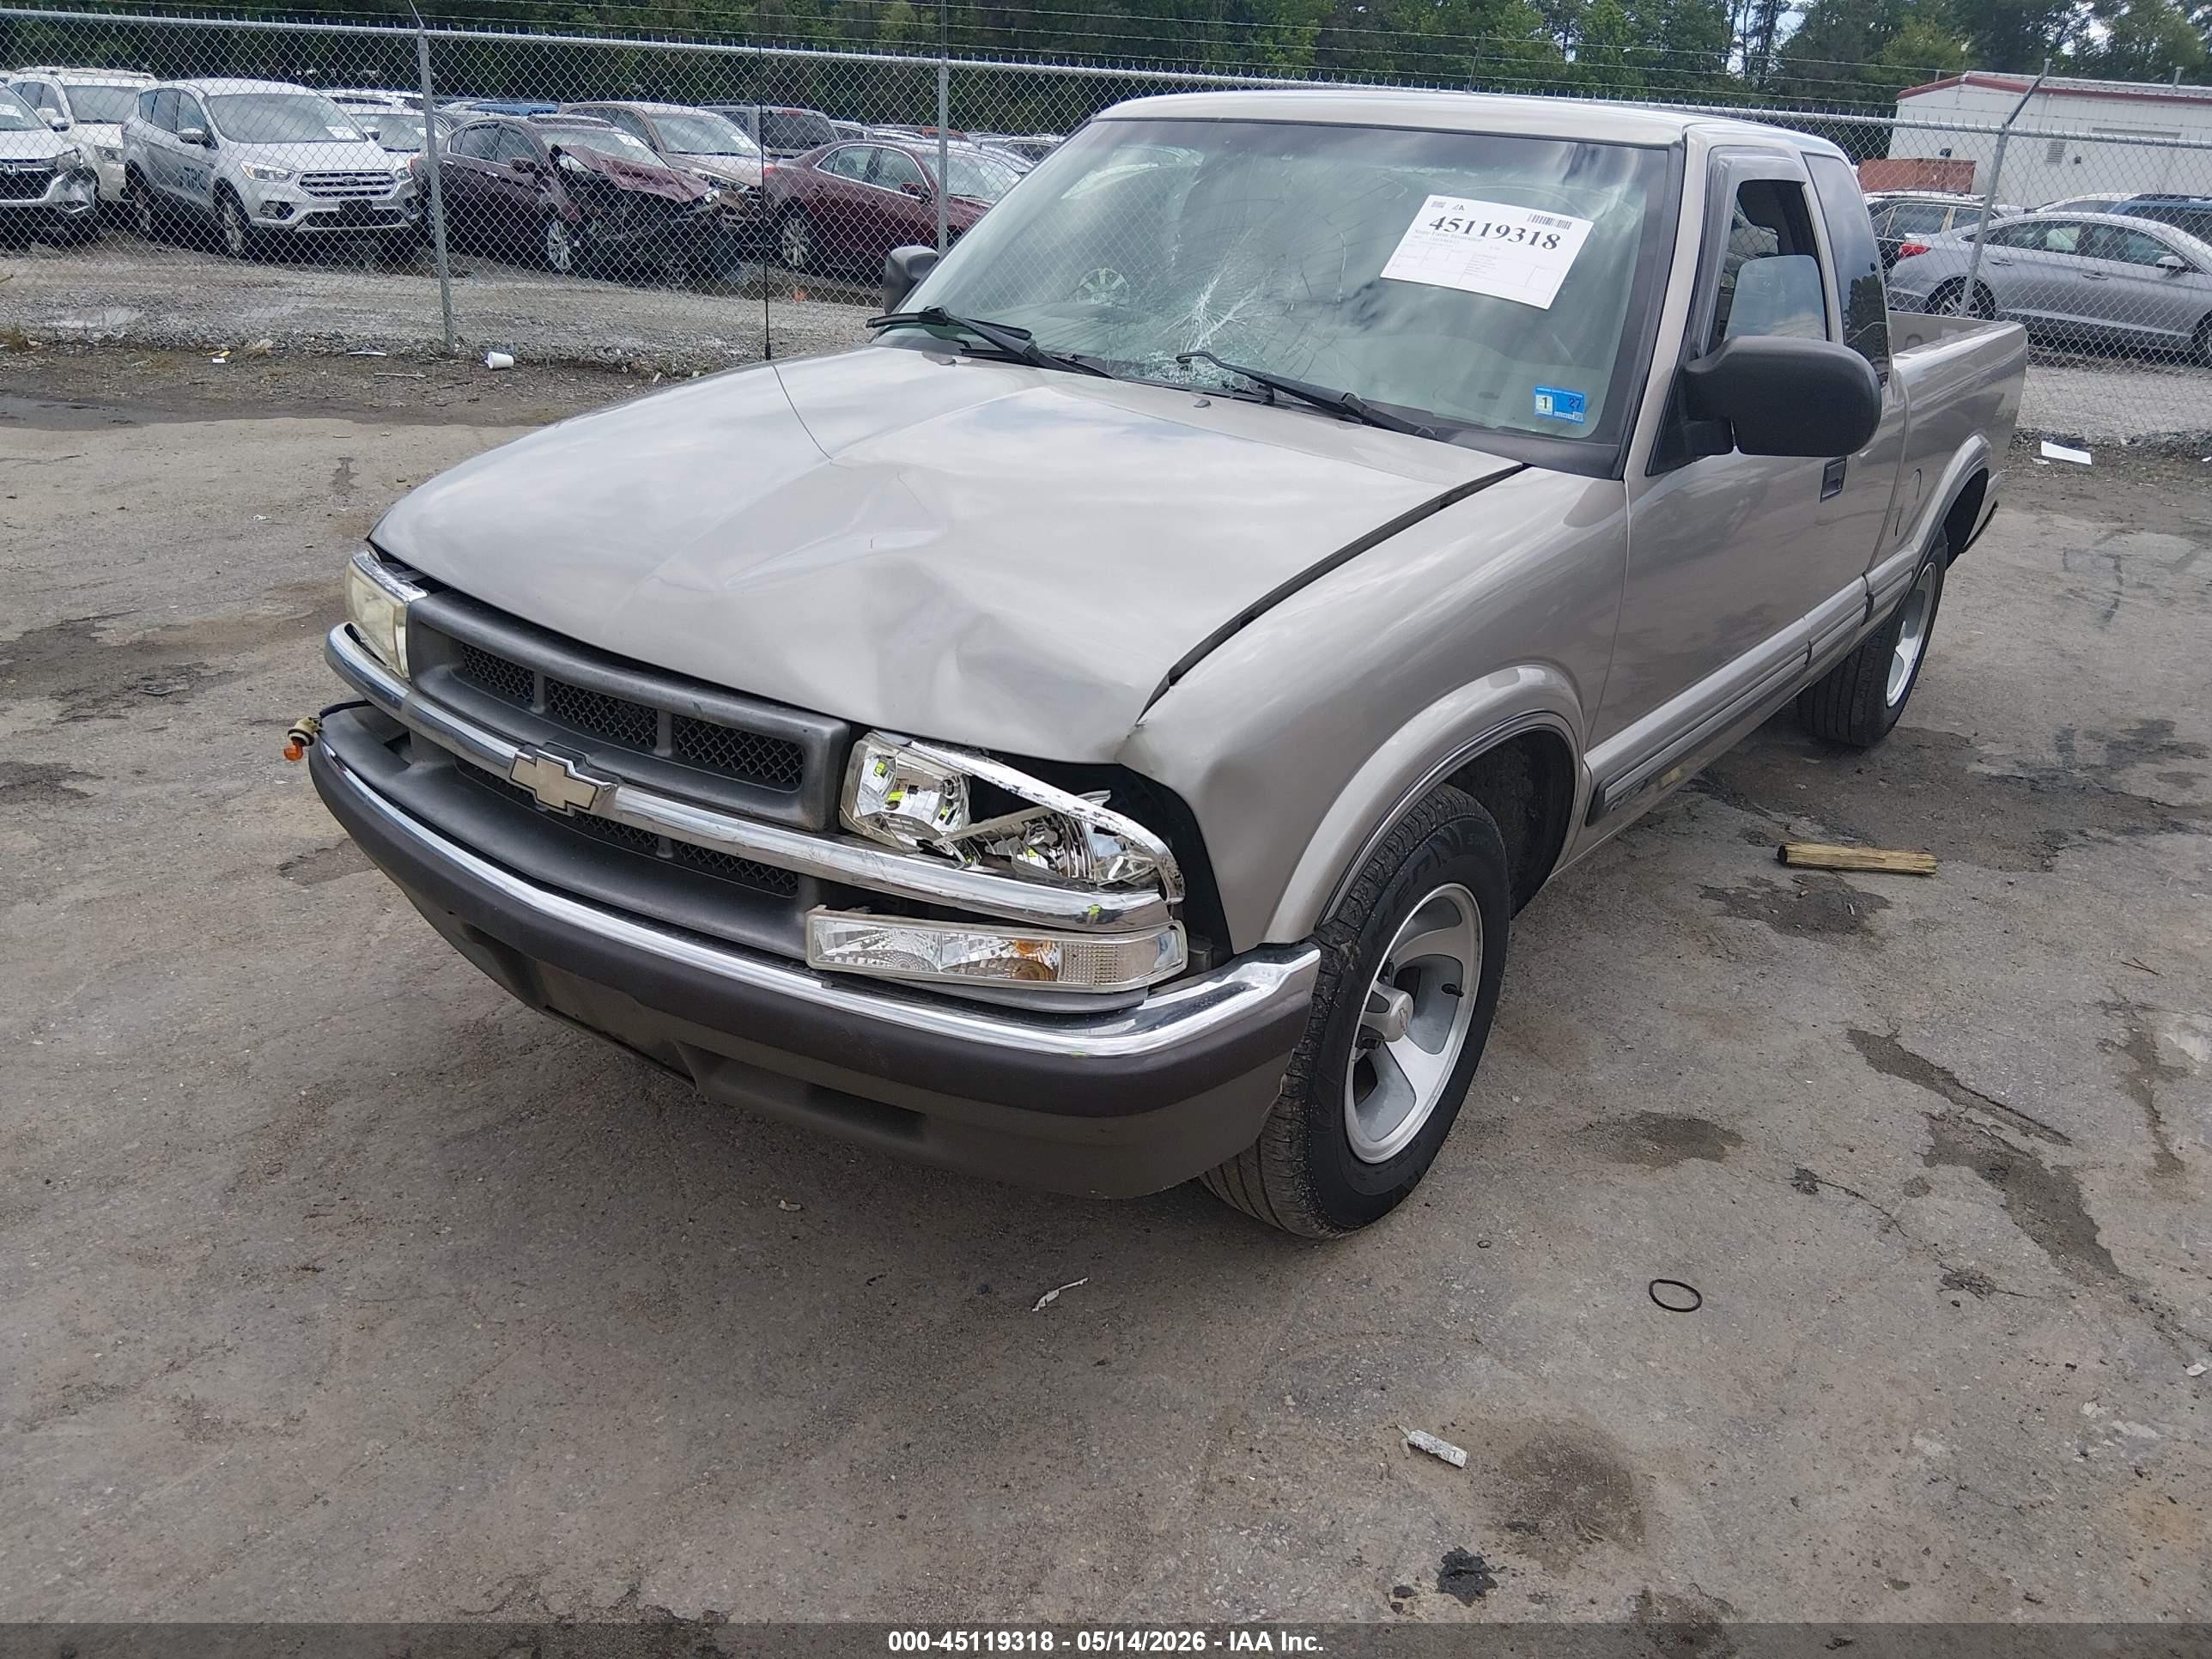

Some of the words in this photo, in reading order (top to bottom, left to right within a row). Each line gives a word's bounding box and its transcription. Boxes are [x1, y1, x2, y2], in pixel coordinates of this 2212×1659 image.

[1429, 216, 1561, 250] 45119318
[1542, 397, 1547, 409] 1
[1568, 397, 1582, 410] 27
